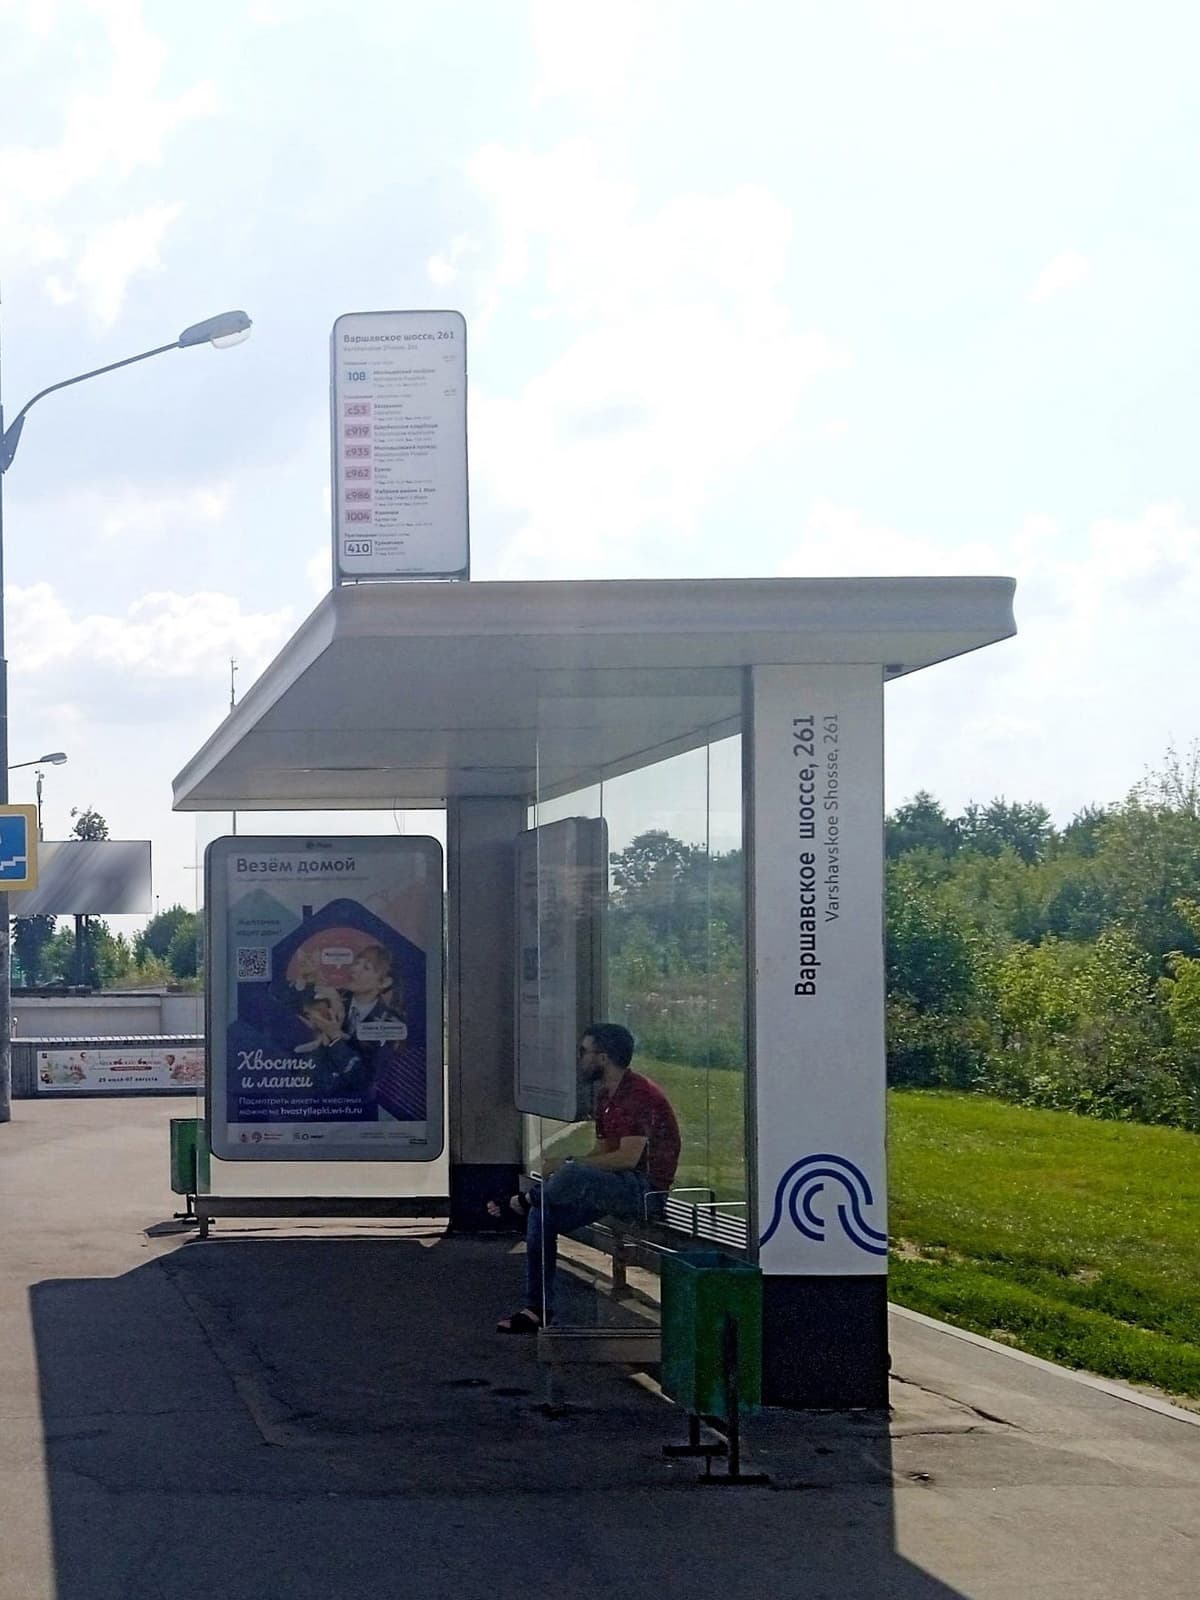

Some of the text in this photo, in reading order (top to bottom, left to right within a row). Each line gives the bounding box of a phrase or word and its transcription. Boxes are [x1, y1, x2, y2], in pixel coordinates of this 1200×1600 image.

[343, 331, 455, 343] Варшавское шоссе, 261
[348, 372, 366, 381] 108
[348, 543, 369, 553] 410
[823, 714, 840, 922] Varshavskoe Shosse, 261
[793, 715, 821, 995] Варшавское шоссе, 261
[237, 857, 356, 873] Везём домой
[237, 1049, 317, 1071] Хвосты
[242, 1076, 314, 1089] и лапки
